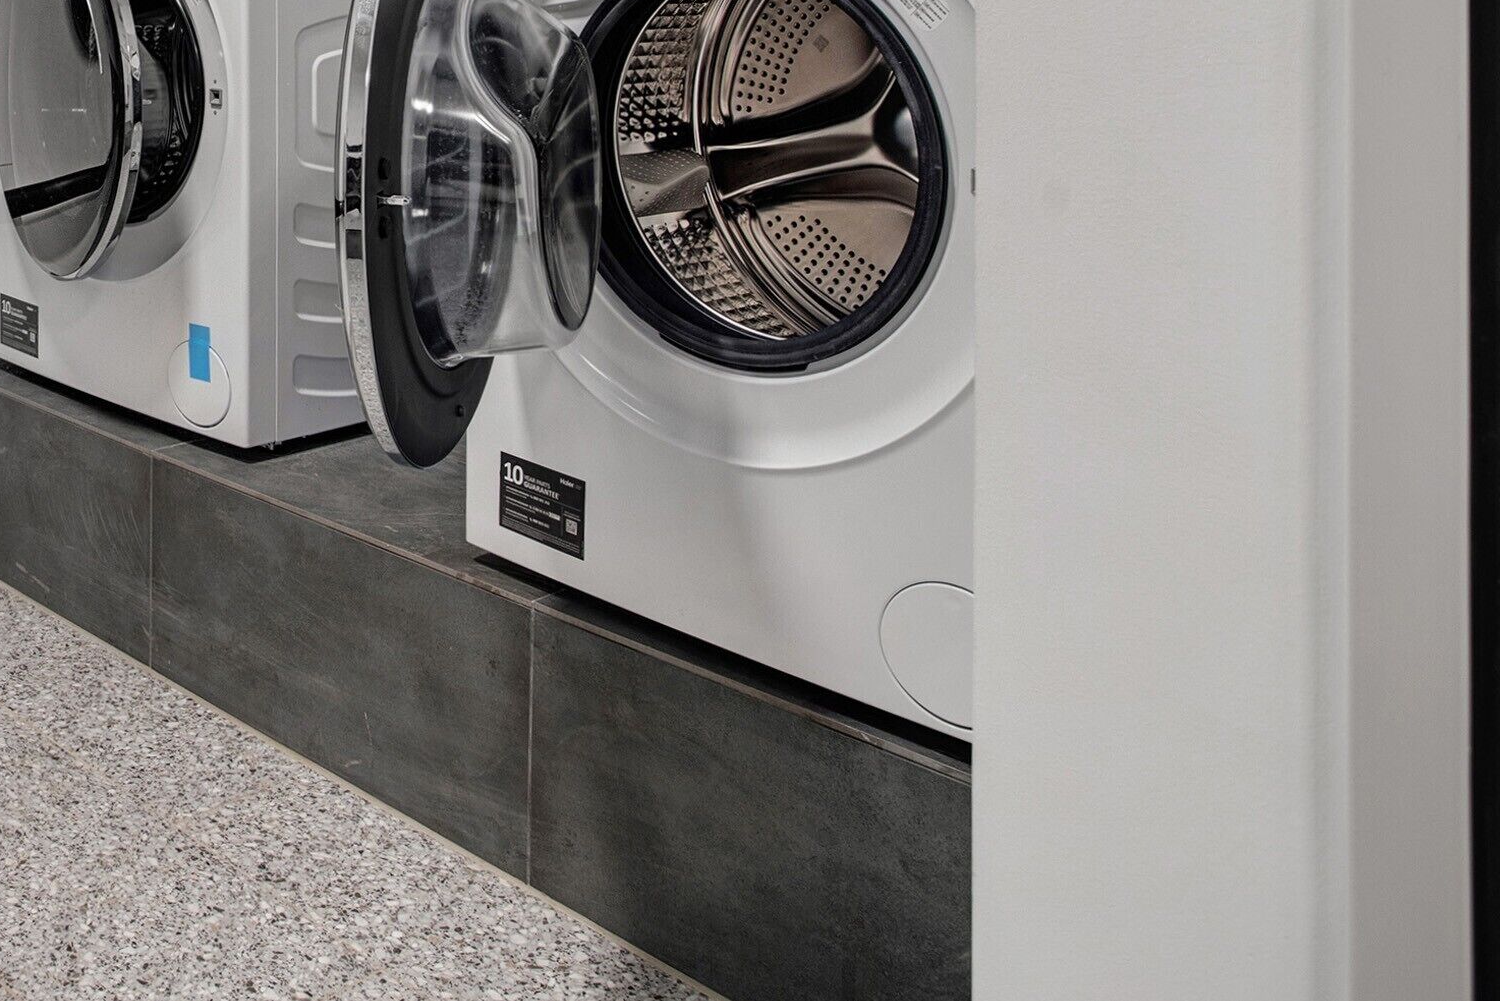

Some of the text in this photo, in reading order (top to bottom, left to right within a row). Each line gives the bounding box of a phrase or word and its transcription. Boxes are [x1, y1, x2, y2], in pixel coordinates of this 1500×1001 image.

[1, 299, 11, 314] 10
[503, 461, 524, 486] 10
[559, 477, 575, 488] Haier
[523, 481, 560, 500] GUARANTEE
